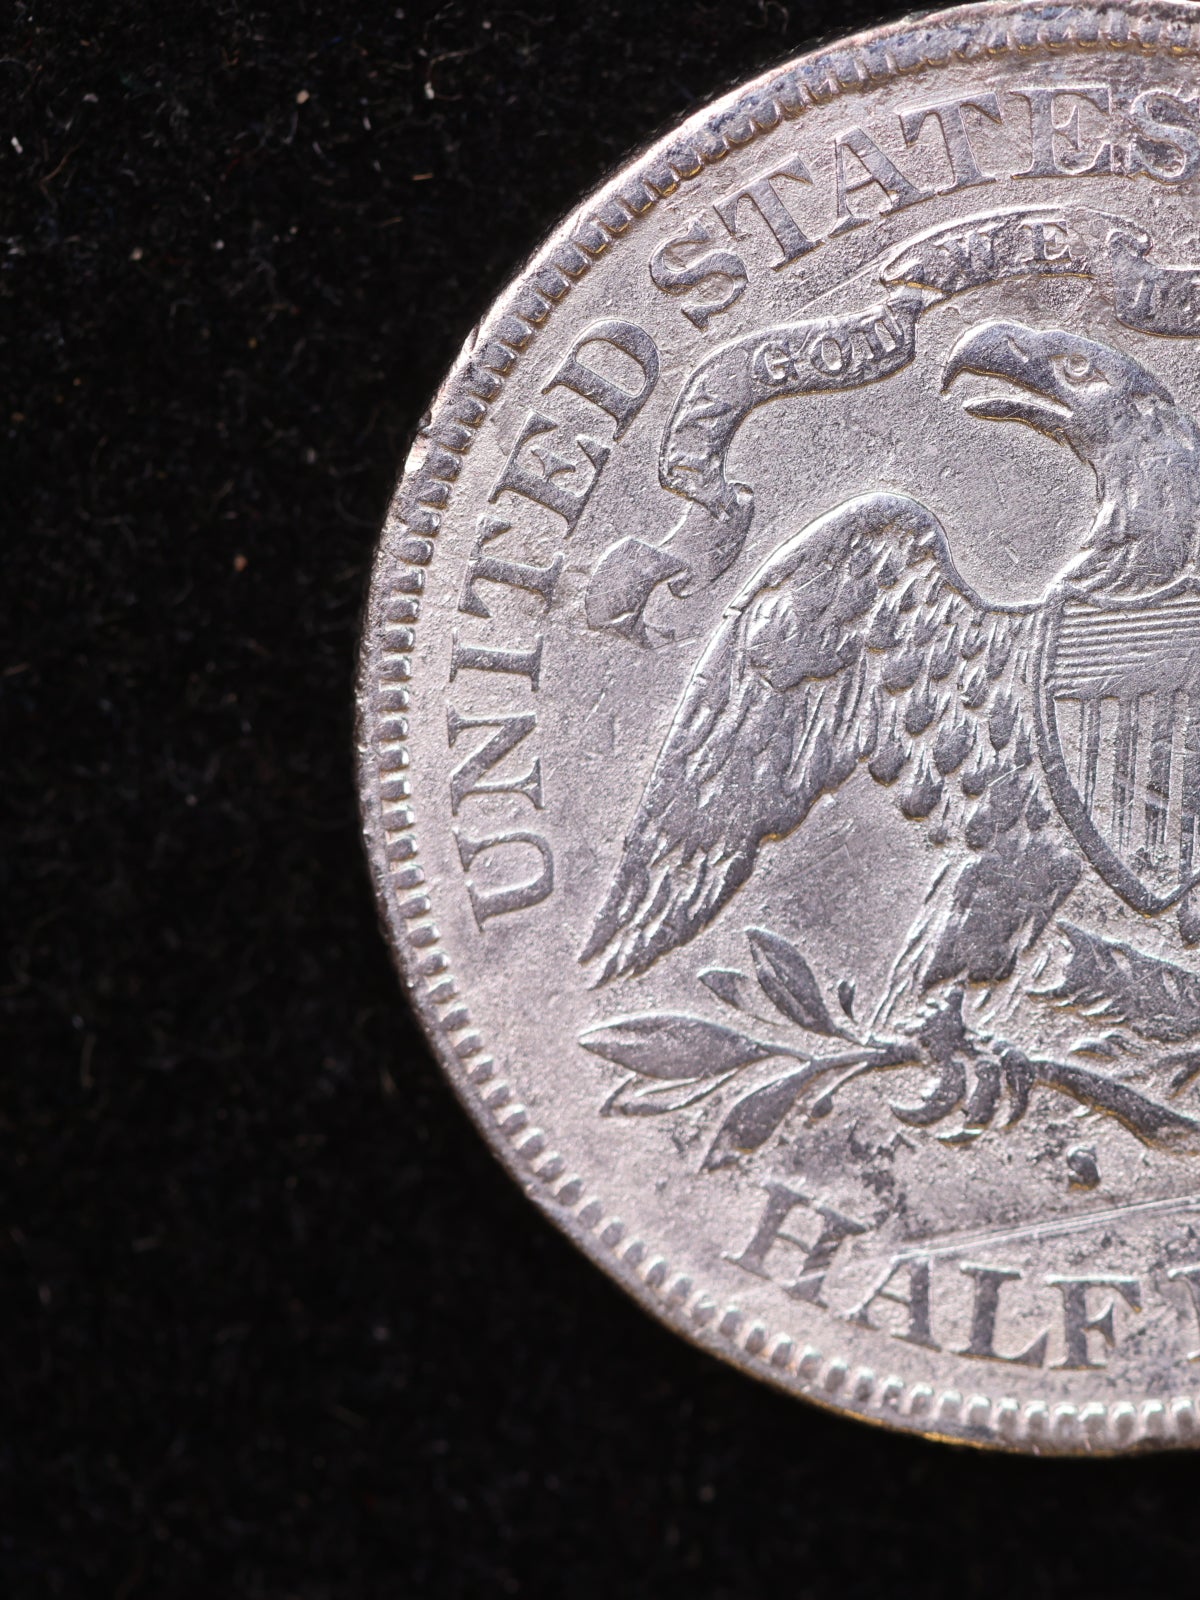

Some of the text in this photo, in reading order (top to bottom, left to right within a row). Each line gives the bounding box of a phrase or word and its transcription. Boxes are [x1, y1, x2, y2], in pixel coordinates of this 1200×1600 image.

[752, 306, 904, 386] GOD
[933, 218, 1074, 278] WE
[448, 319, 660, 930] UNITED
[649, 85, 1200, 329] STATES
[723, 1180, 1145, 1370] HALF
